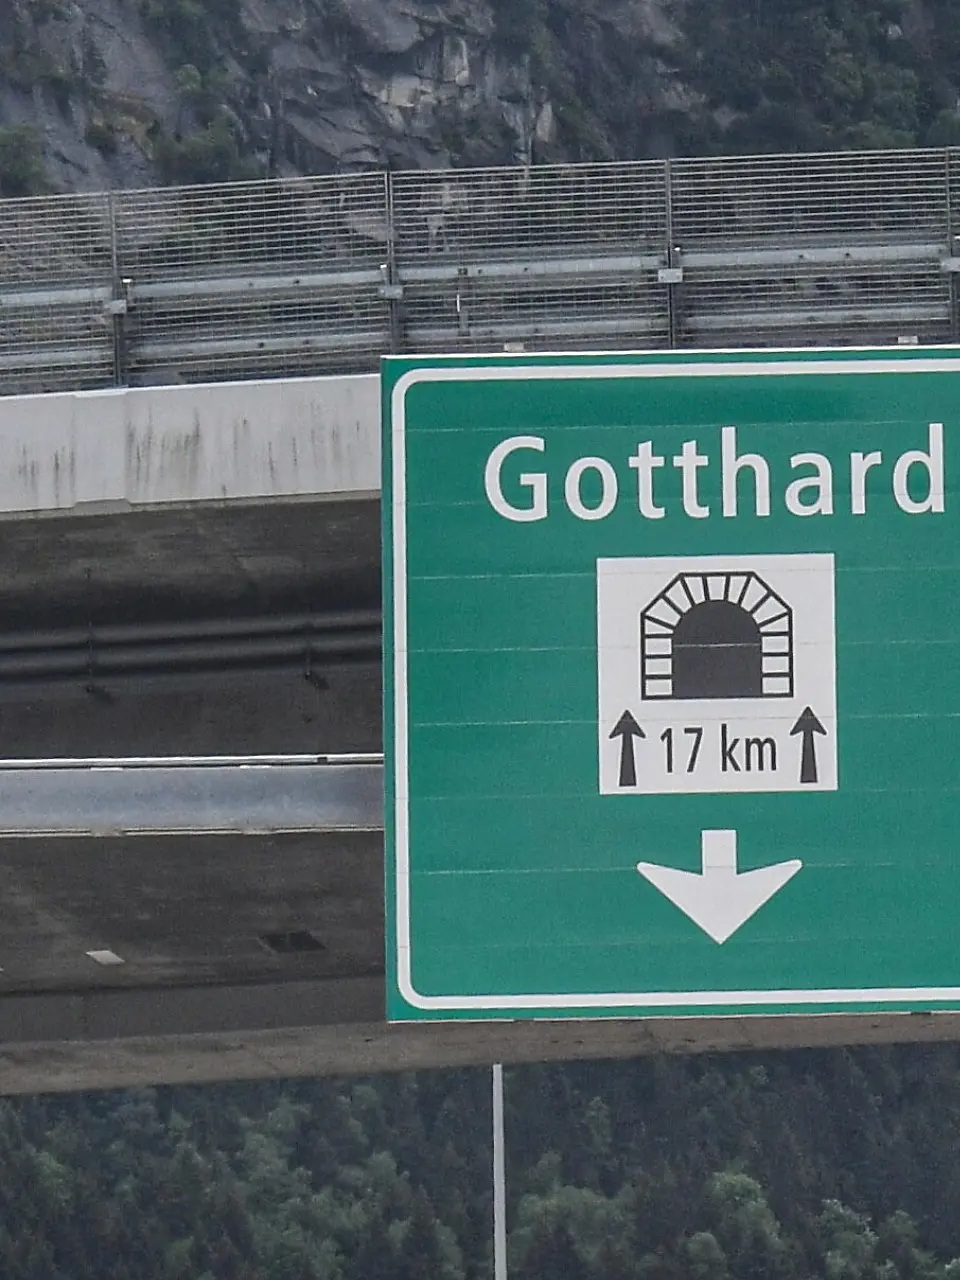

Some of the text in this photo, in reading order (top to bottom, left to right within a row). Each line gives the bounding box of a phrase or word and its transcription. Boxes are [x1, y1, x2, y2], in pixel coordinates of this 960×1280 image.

[484, 422, 945, 522] Gotthard
[660, 723, 777, 774] 17 km
